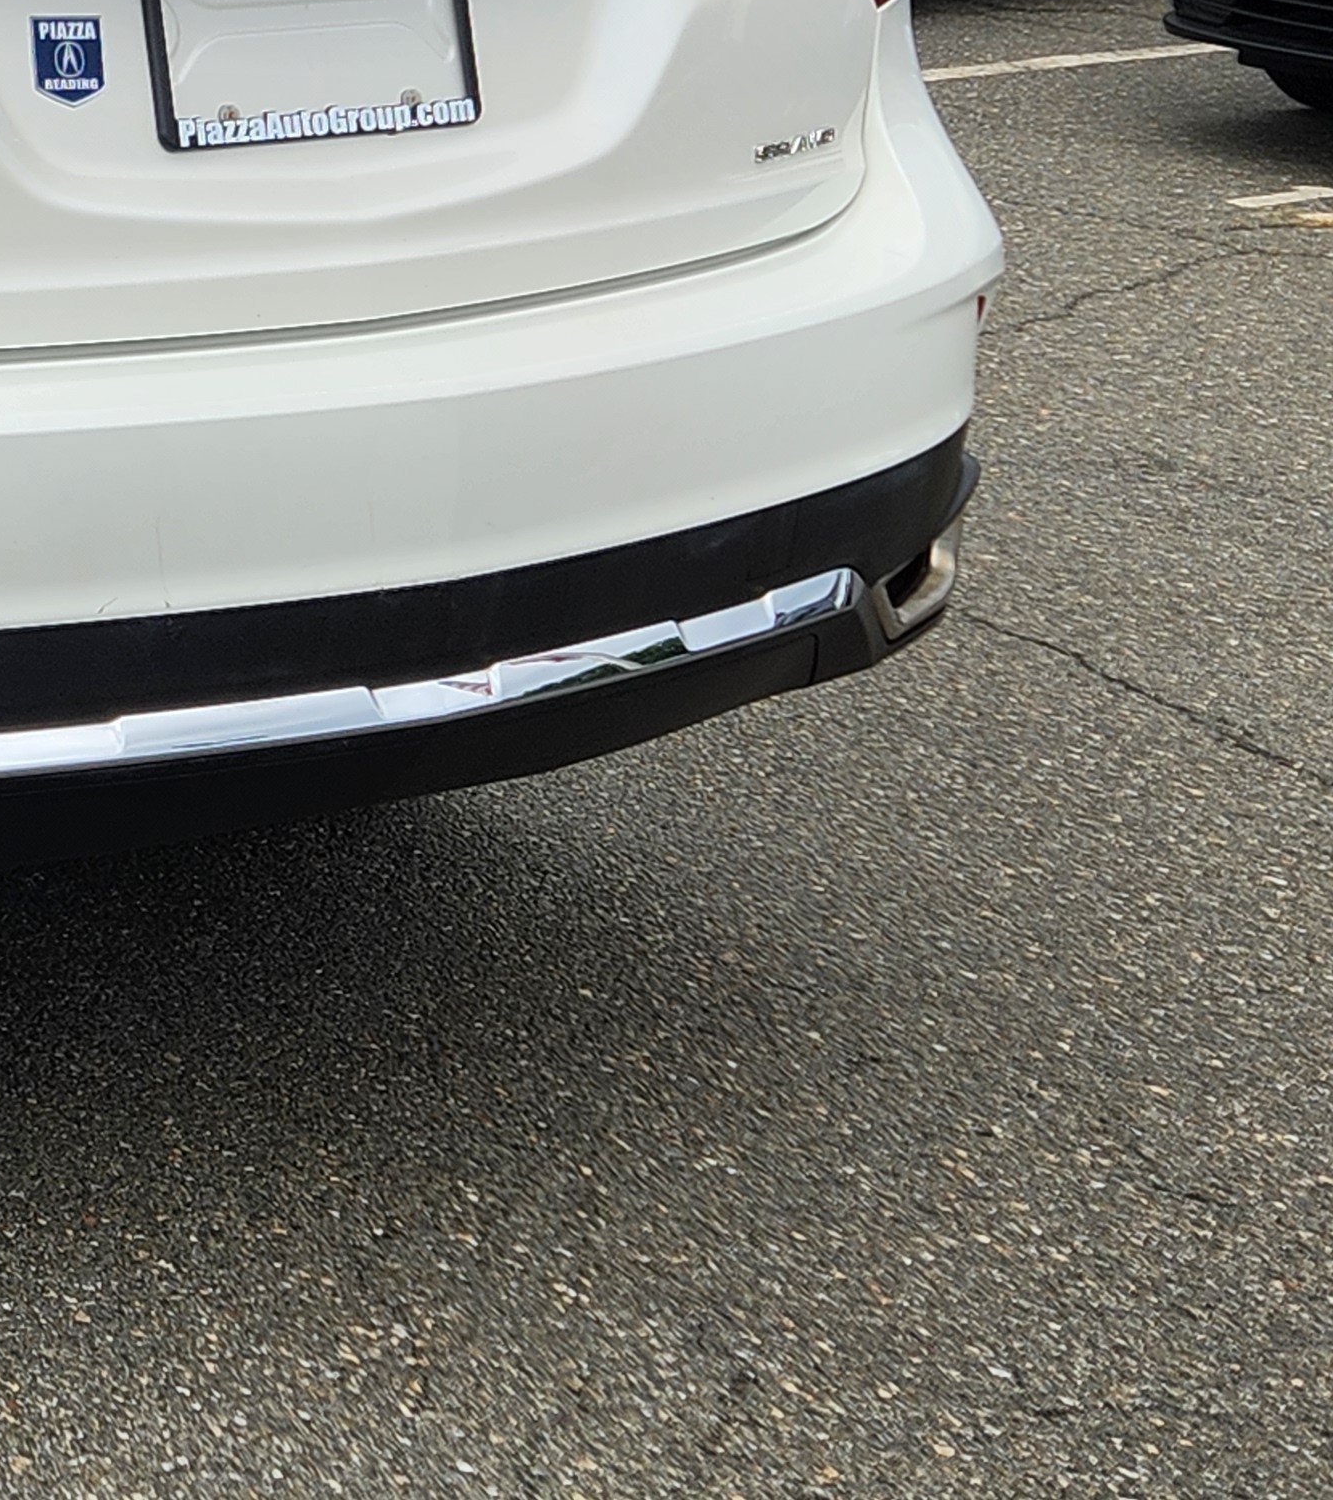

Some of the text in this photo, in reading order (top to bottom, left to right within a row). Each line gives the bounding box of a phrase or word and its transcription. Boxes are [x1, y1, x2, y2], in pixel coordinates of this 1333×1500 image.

[37, 21, 97, 40] PIAZZA
[44, 78, 100, 91] READING
[177, 97, 477, 148] PiazzaAutoGroup.com
